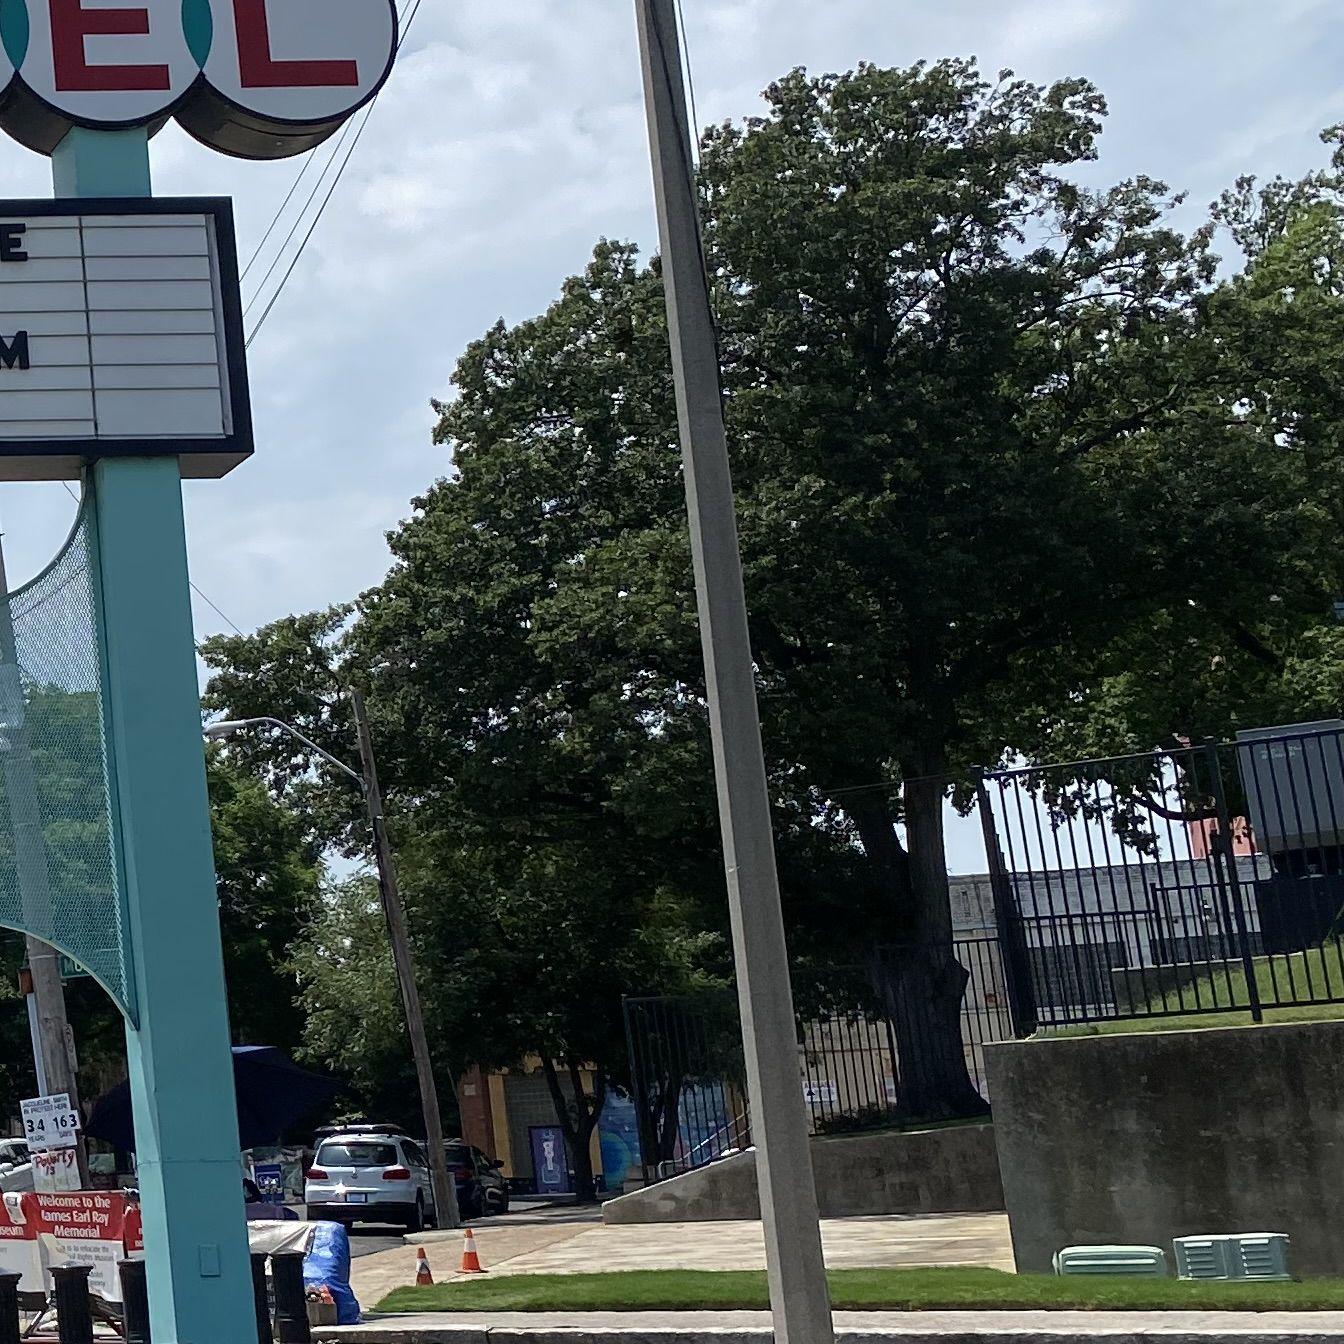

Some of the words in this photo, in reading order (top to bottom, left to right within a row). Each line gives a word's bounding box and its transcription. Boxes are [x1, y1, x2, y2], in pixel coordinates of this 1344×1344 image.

[37, 1195, 81, 1207] Welcome
[83, 1197, 92, 1207] to
[94, 1196, 111, 1208] the
[73, 1210, 90, 1223] Earl
[92, 1211, 109, 1226] Ray
[54, 1225, 101, 1237] Memorial
